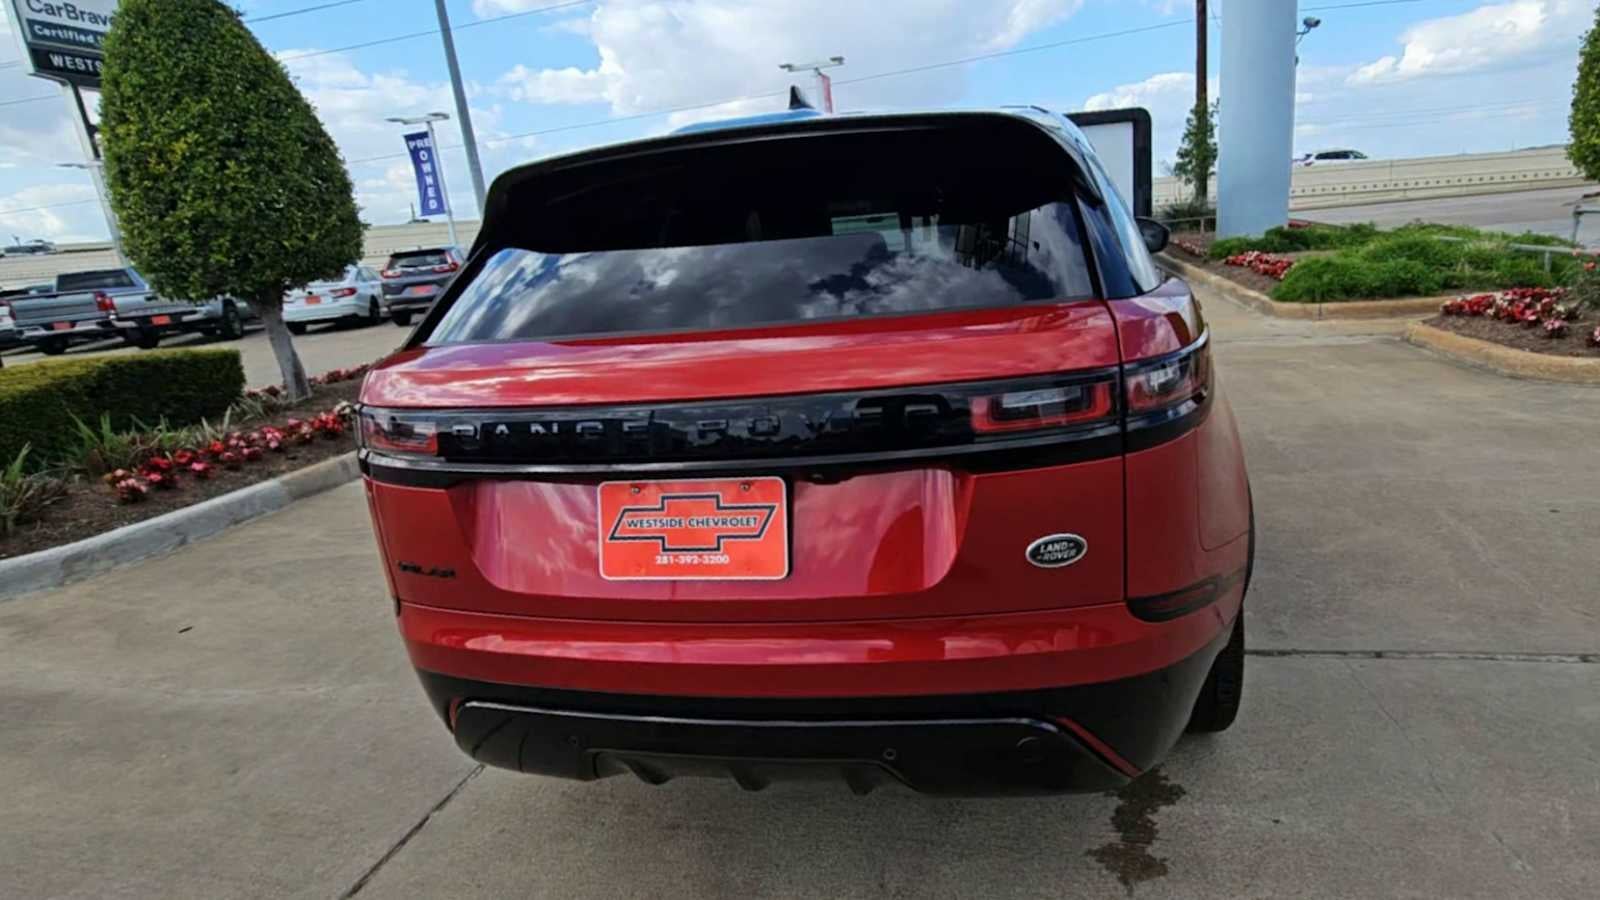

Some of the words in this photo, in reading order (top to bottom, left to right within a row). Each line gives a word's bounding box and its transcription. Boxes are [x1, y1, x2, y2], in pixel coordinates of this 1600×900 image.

[33, 24, 95, 44] Certified
[408, 138, 432, 149] PRE
[419, 150, 438, 209] OWNED
[626, 518, 684, 528] WESTSIDE
[688, 516, 758, 528] CHEVROLET
[1040, 541, 1068, 553] LAND
[655, 554, 730, 565] 281-392-3200
[1042, 548, 1077, 561] ROVER
